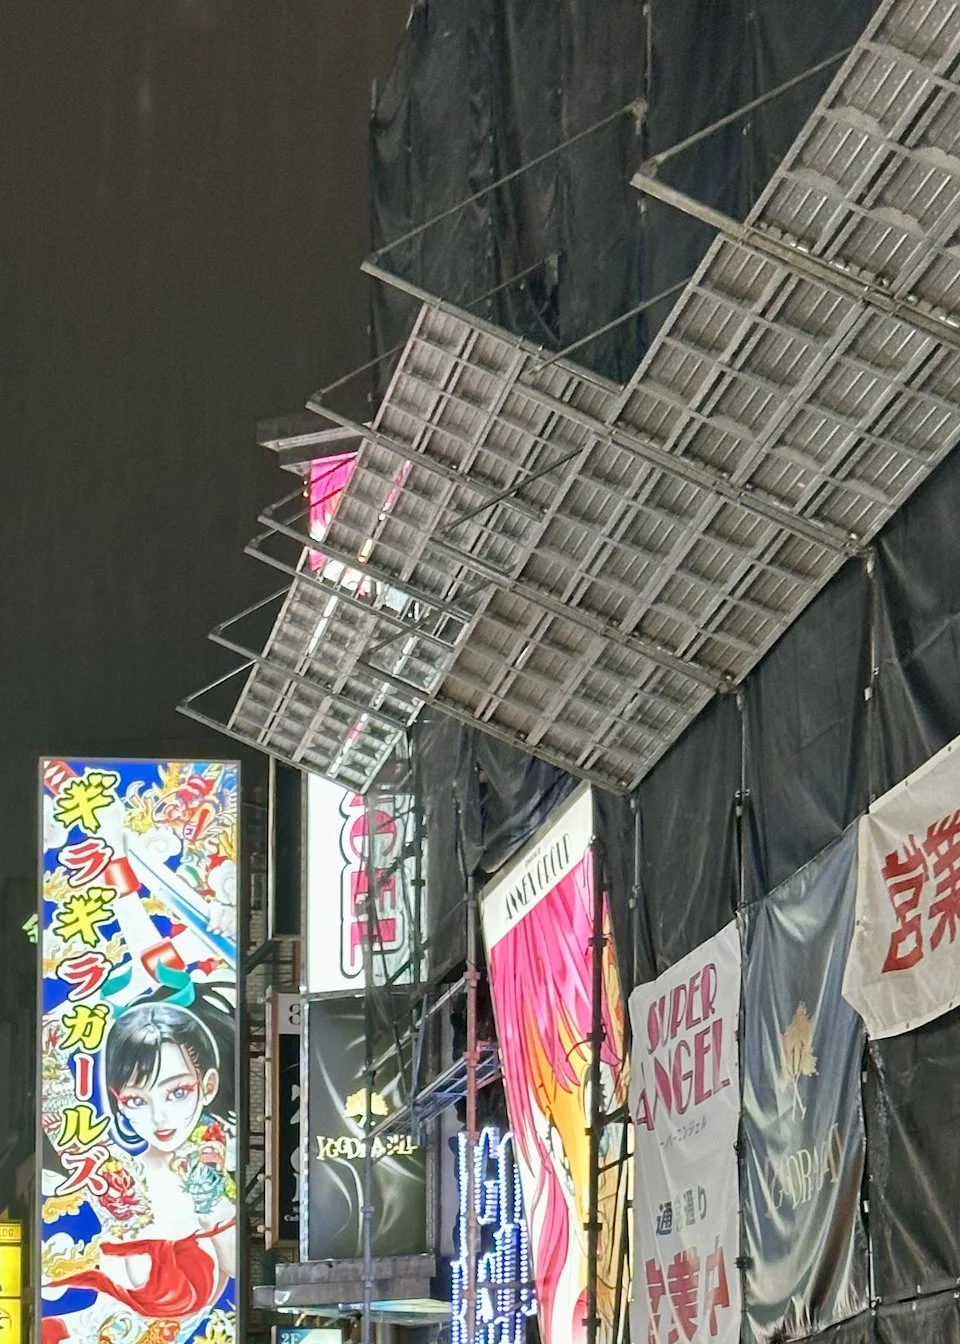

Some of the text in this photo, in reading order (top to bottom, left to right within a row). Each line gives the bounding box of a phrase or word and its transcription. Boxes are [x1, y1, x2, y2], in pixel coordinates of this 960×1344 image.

[55, 771, 117, 1197] ギラギラガールズ
[647, 962, 718, 1056] SUPER
[636, 1018, 730, 1132] ANGEL
